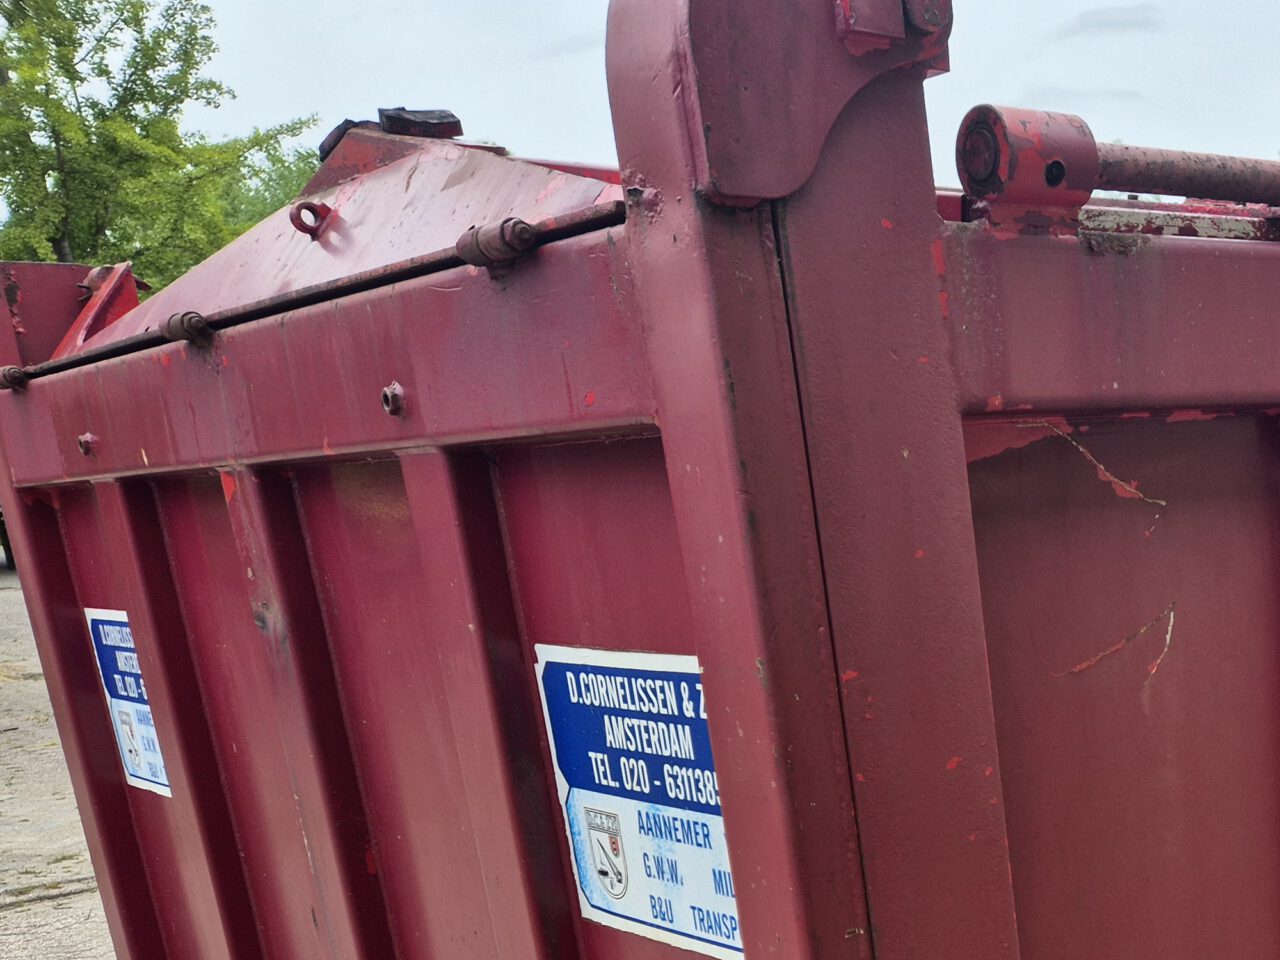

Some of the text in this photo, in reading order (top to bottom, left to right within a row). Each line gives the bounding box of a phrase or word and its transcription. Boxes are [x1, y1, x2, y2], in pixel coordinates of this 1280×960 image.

[565, 671, 679, 716] D.CORNELISSEN
[680, 681, 696, 718] &
[603, 714, 695, 760] AMSTERDAM
[588, 751, 620, 788] TEL.
[620, 756, 650, 794] 020
[637, 809, 713, 850] AANNEMER
[649, 894, 674, 924] B&U
[689, 905, 738, 941] TRANSP
